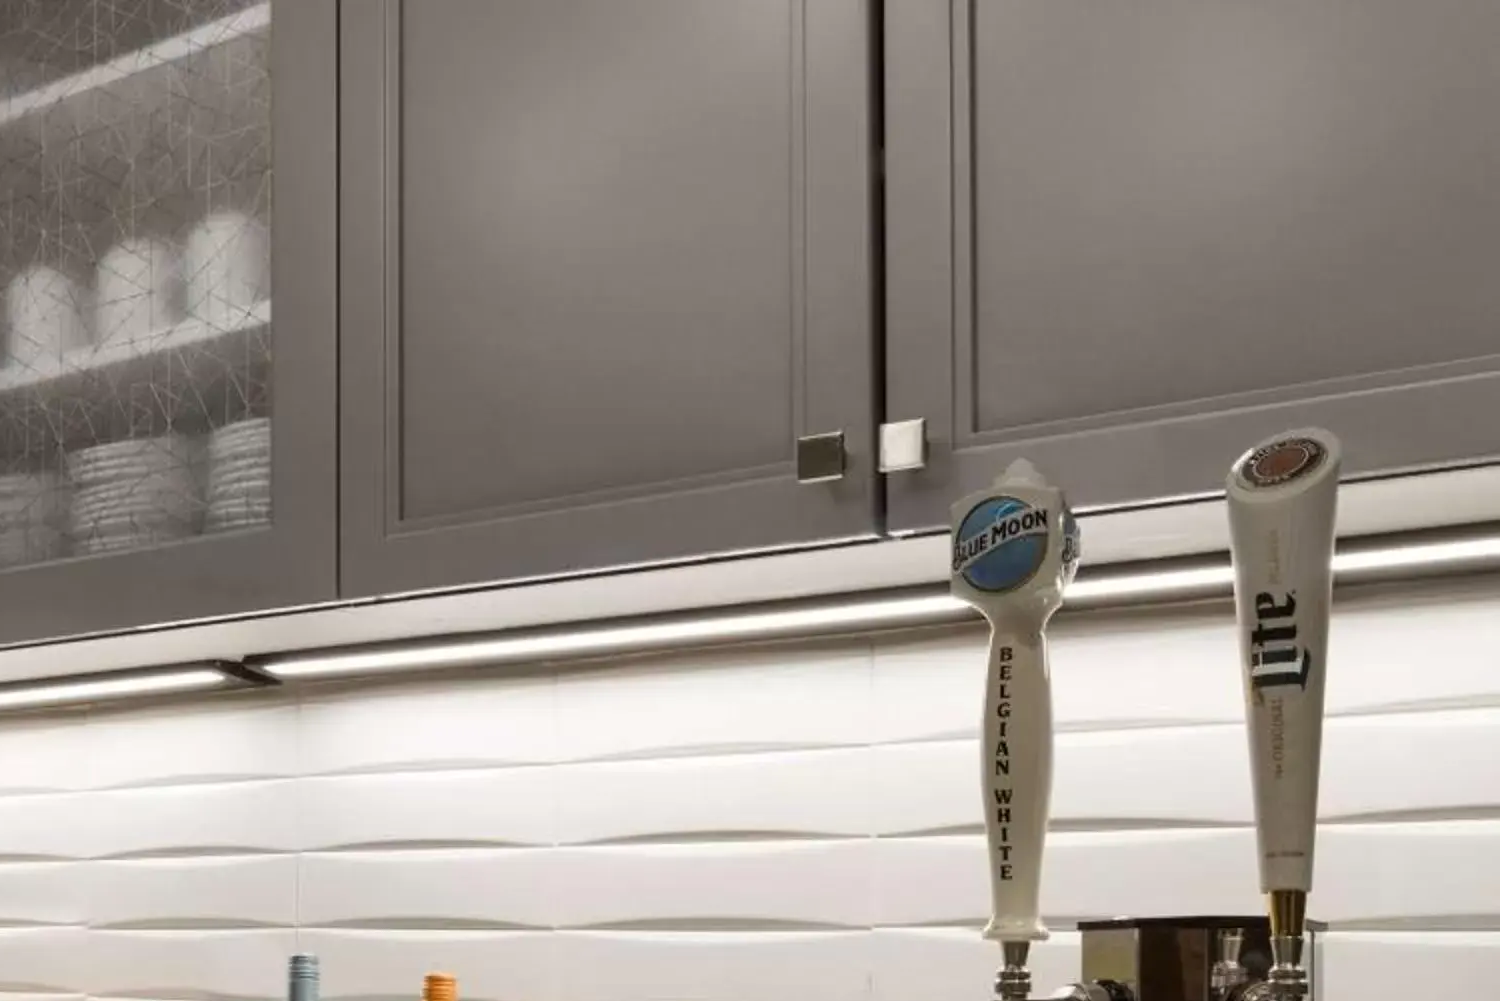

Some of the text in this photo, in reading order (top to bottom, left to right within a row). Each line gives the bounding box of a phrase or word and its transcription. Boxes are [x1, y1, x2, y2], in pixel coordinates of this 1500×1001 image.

[953, 509, 1048, 571] BLUE MOON
[1252, 591, 1311, 694] Lite
[994, 647, 1013, 881] BELGIAN WHITE
